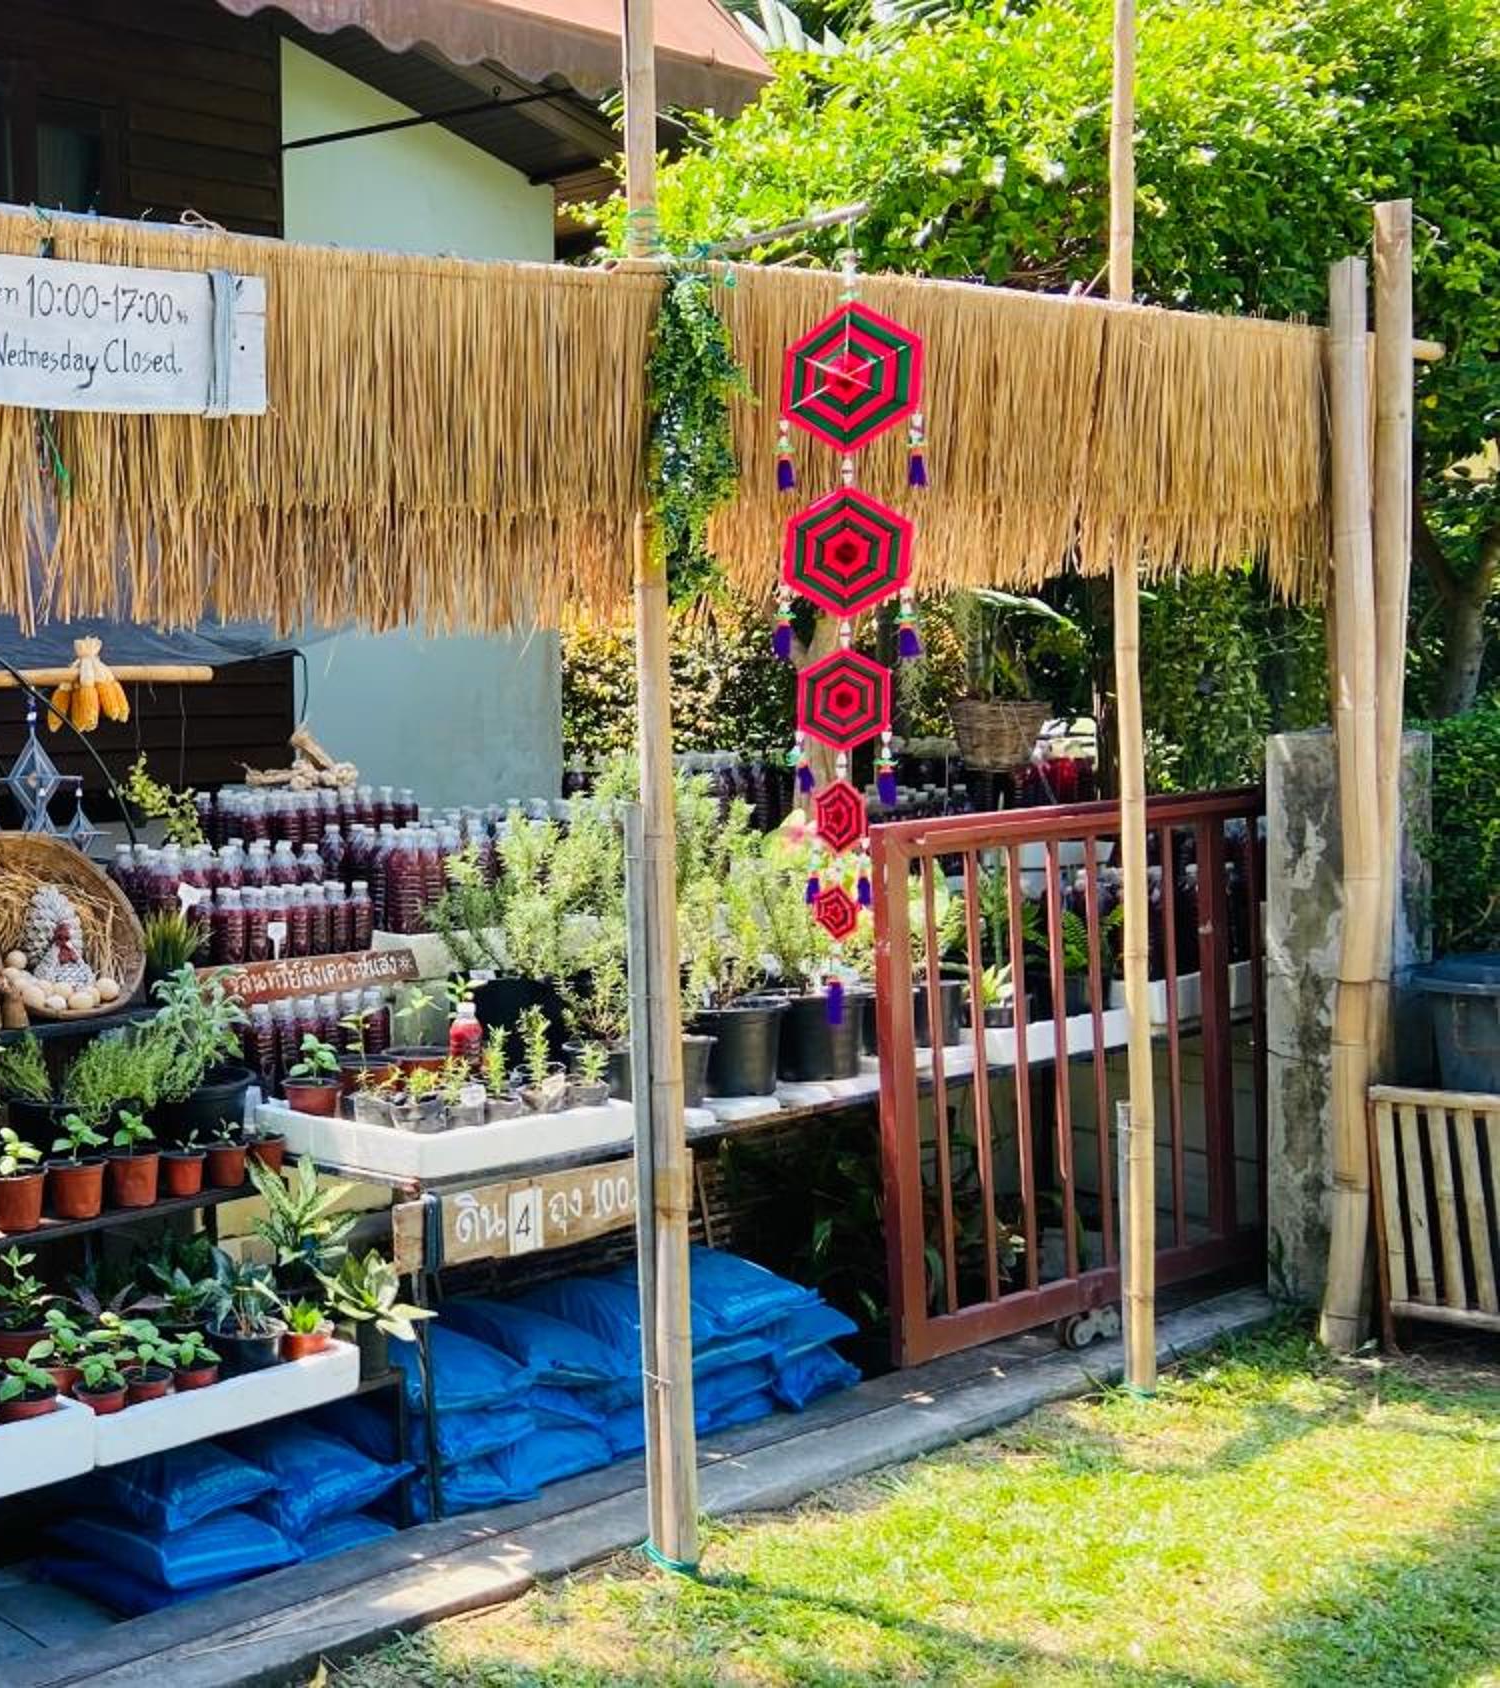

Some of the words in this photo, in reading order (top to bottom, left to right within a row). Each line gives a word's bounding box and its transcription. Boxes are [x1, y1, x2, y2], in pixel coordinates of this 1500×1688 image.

[454, 1193, 507, 1243] ดิน
[515, 1204, 532, 1237] 4
[549, 1188, 583, 1237] ถุง
